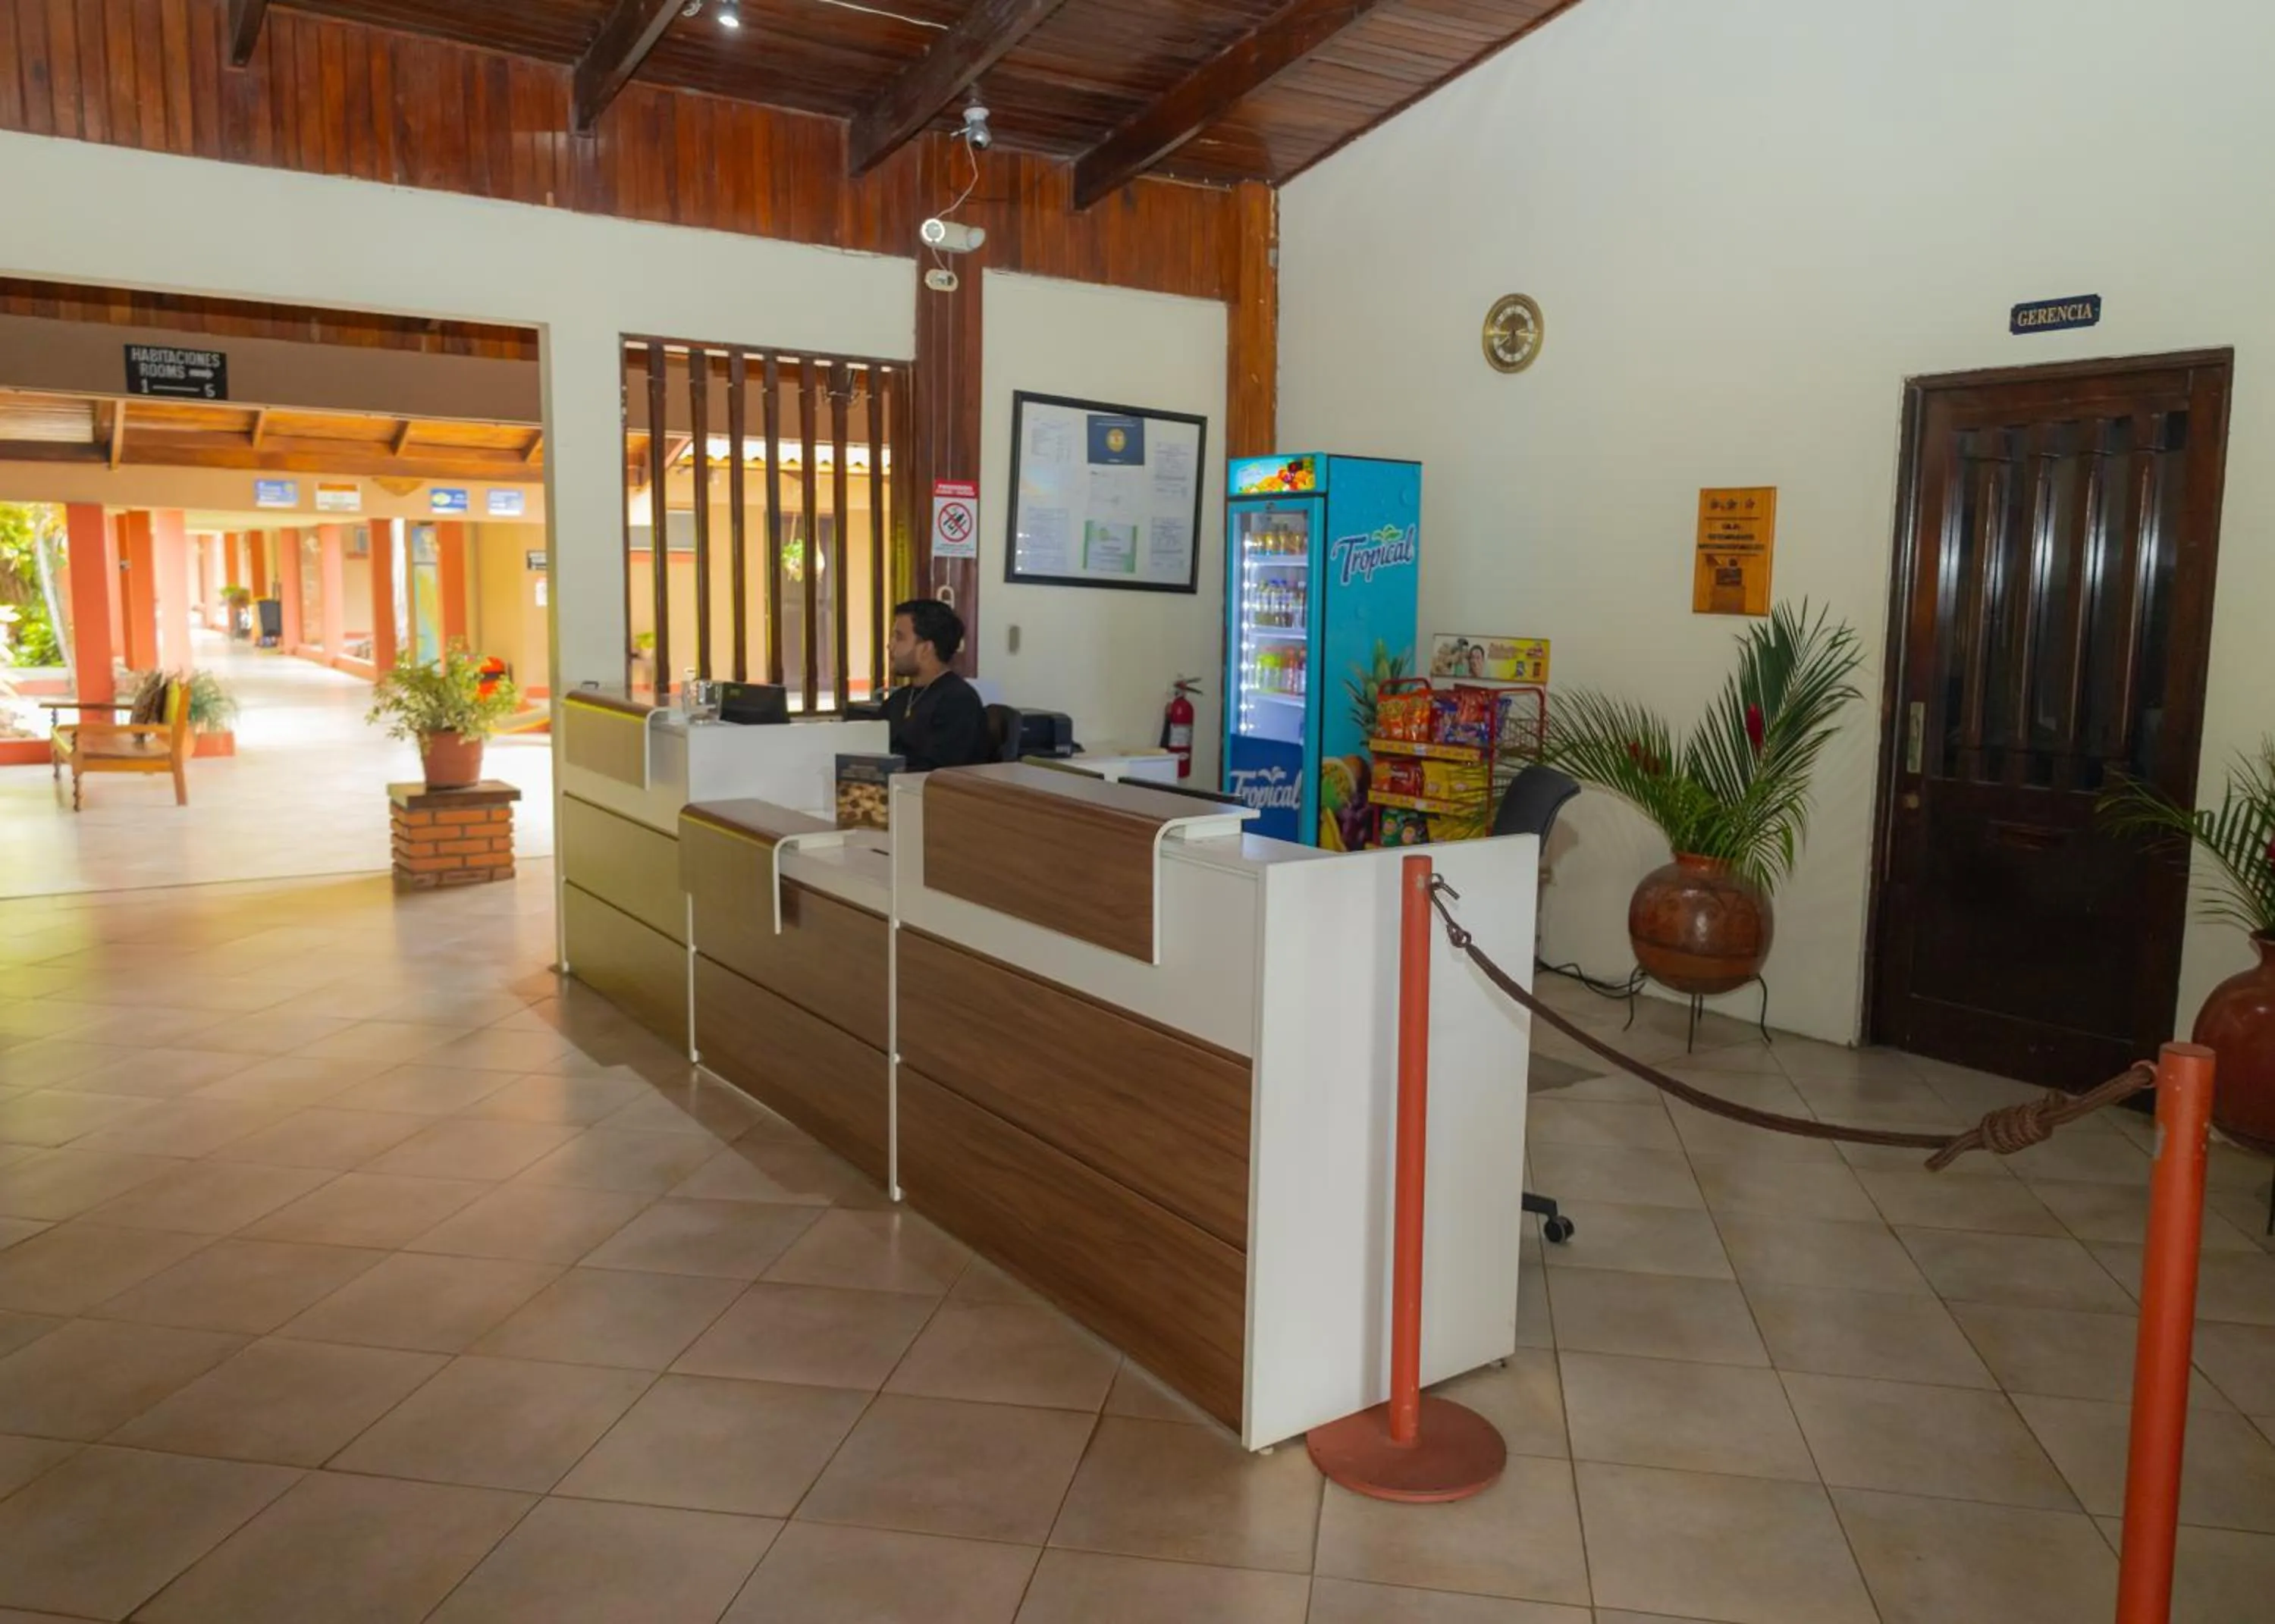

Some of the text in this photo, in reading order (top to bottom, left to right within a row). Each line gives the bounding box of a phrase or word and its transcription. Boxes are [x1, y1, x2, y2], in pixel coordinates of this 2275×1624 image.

[2018, 303, 2092, 326] GERENCIA
[132, 347, 220, 368] HABITACIONES
[140, 363, 185, 378] ROOMS
[1330, 523, 1415, 585] Tropical
[1228, 769, 1303, 810] Tropical
